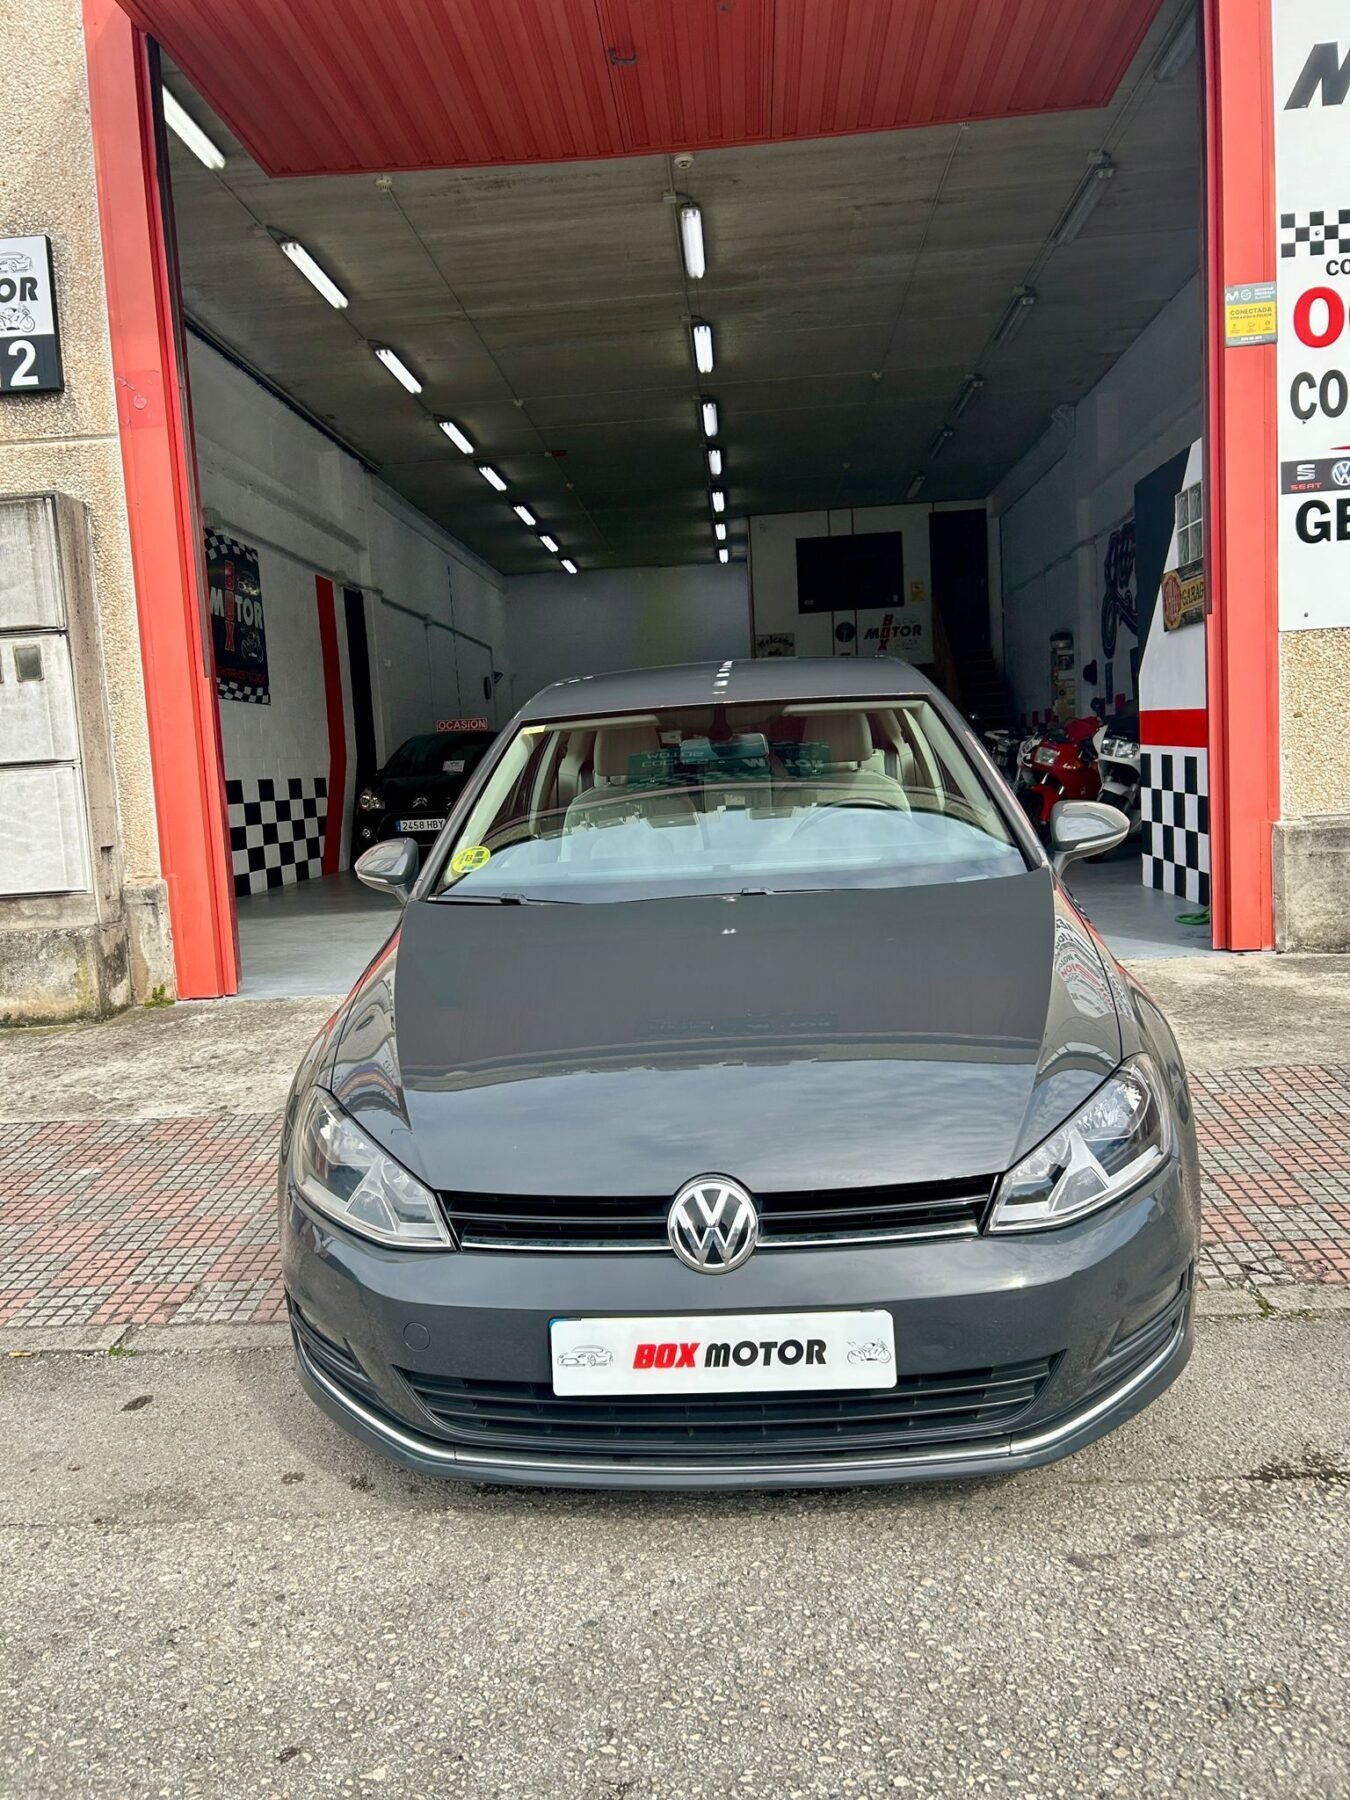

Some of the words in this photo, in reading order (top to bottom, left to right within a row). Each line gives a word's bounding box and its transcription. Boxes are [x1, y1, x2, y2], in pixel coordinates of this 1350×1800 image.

[1326, 259, 1350, 276] CO
[0, 277, 38, 303] OR
[1294, 287, 1350, 348] O
[0, 339, 39, 387] 2
[1290, 482, 1322, 491] SEAT
[438, 720, 486, 730] OCASION
[402, 821, 425, 830] 2458
[427, 820, 444, 829] HBY
[633, 1342, 701, 1369] BOX
[704, 1338, 827, 1368] MOTOR
